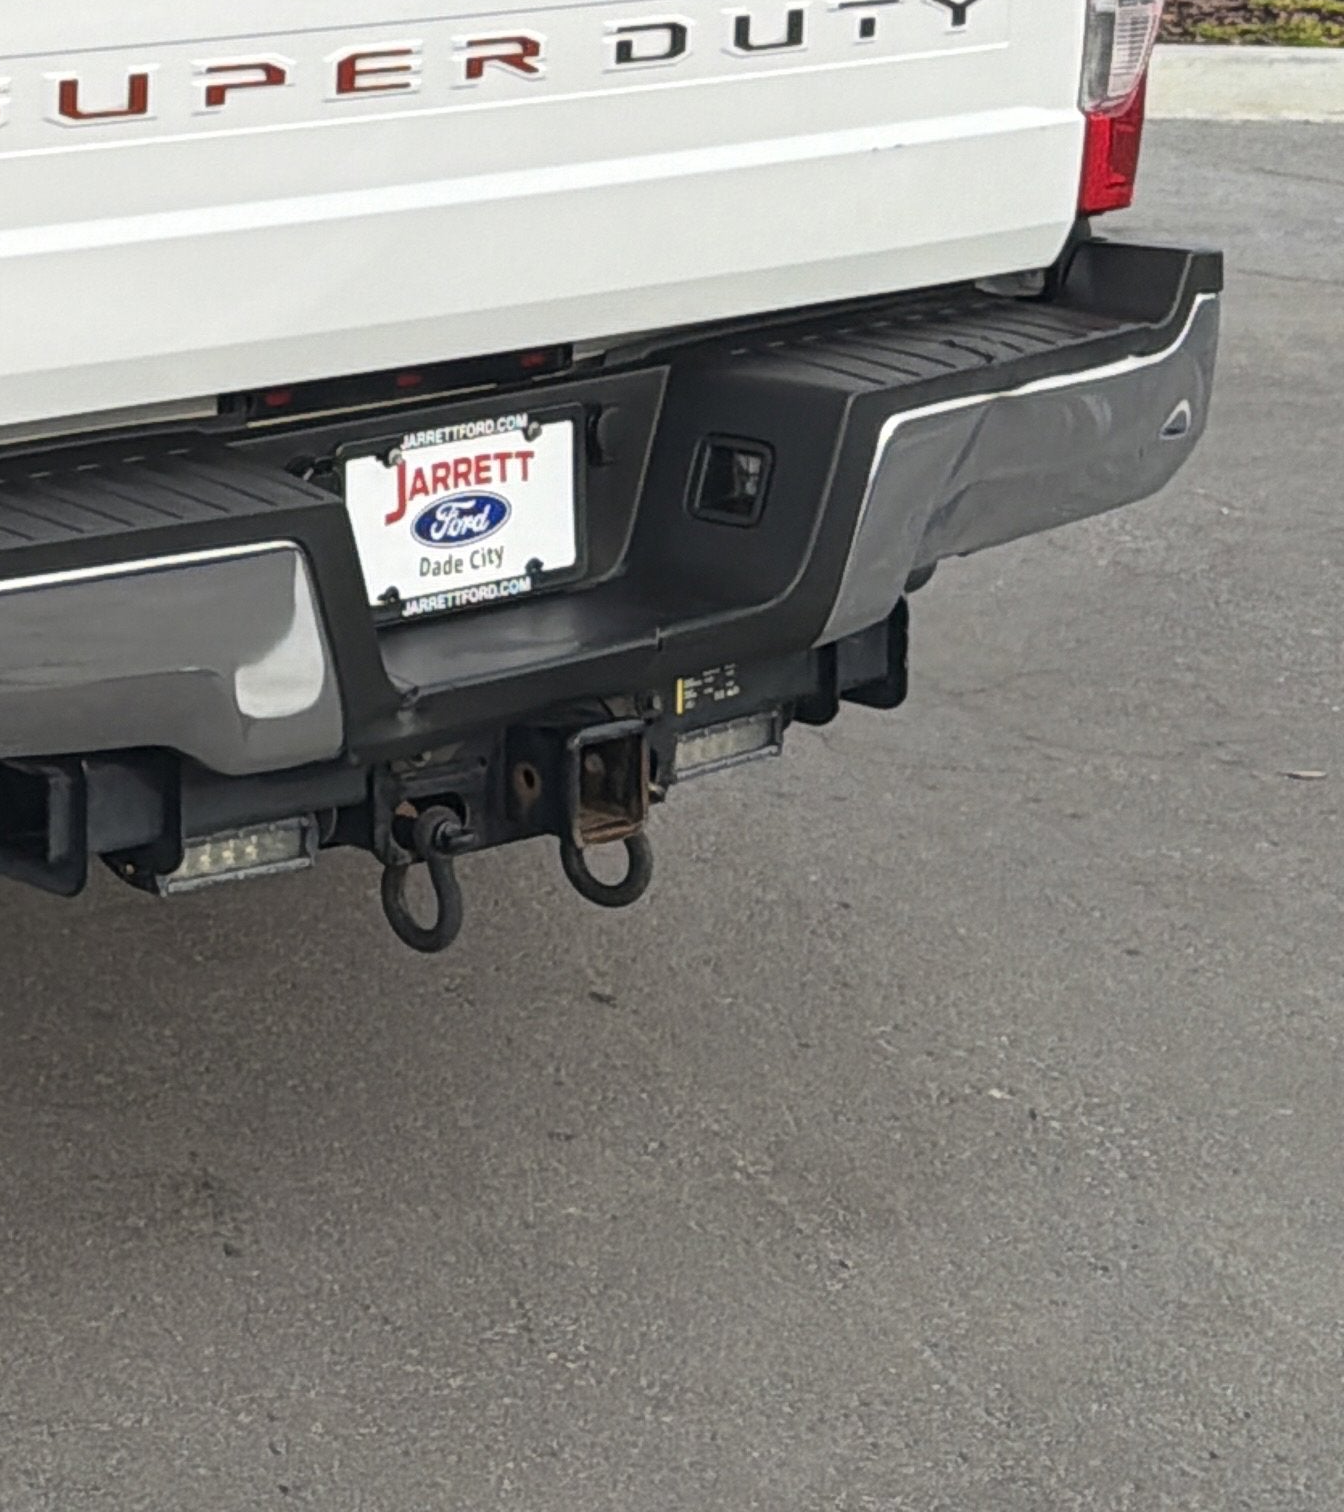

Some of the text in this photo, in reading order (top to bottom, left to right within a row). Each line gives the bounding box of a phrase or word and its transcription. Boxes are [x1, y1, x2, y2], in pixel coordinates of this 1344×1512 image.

[401, 414, 528, 449] JARRETTFORD.COM
[384, 451, 534, 526] JARRETT
[430, 498, 490, 541] Ford
[419, 545, 504, 577] Dade City
[402, 576, 532, 617] JARRETTFORD.COM
